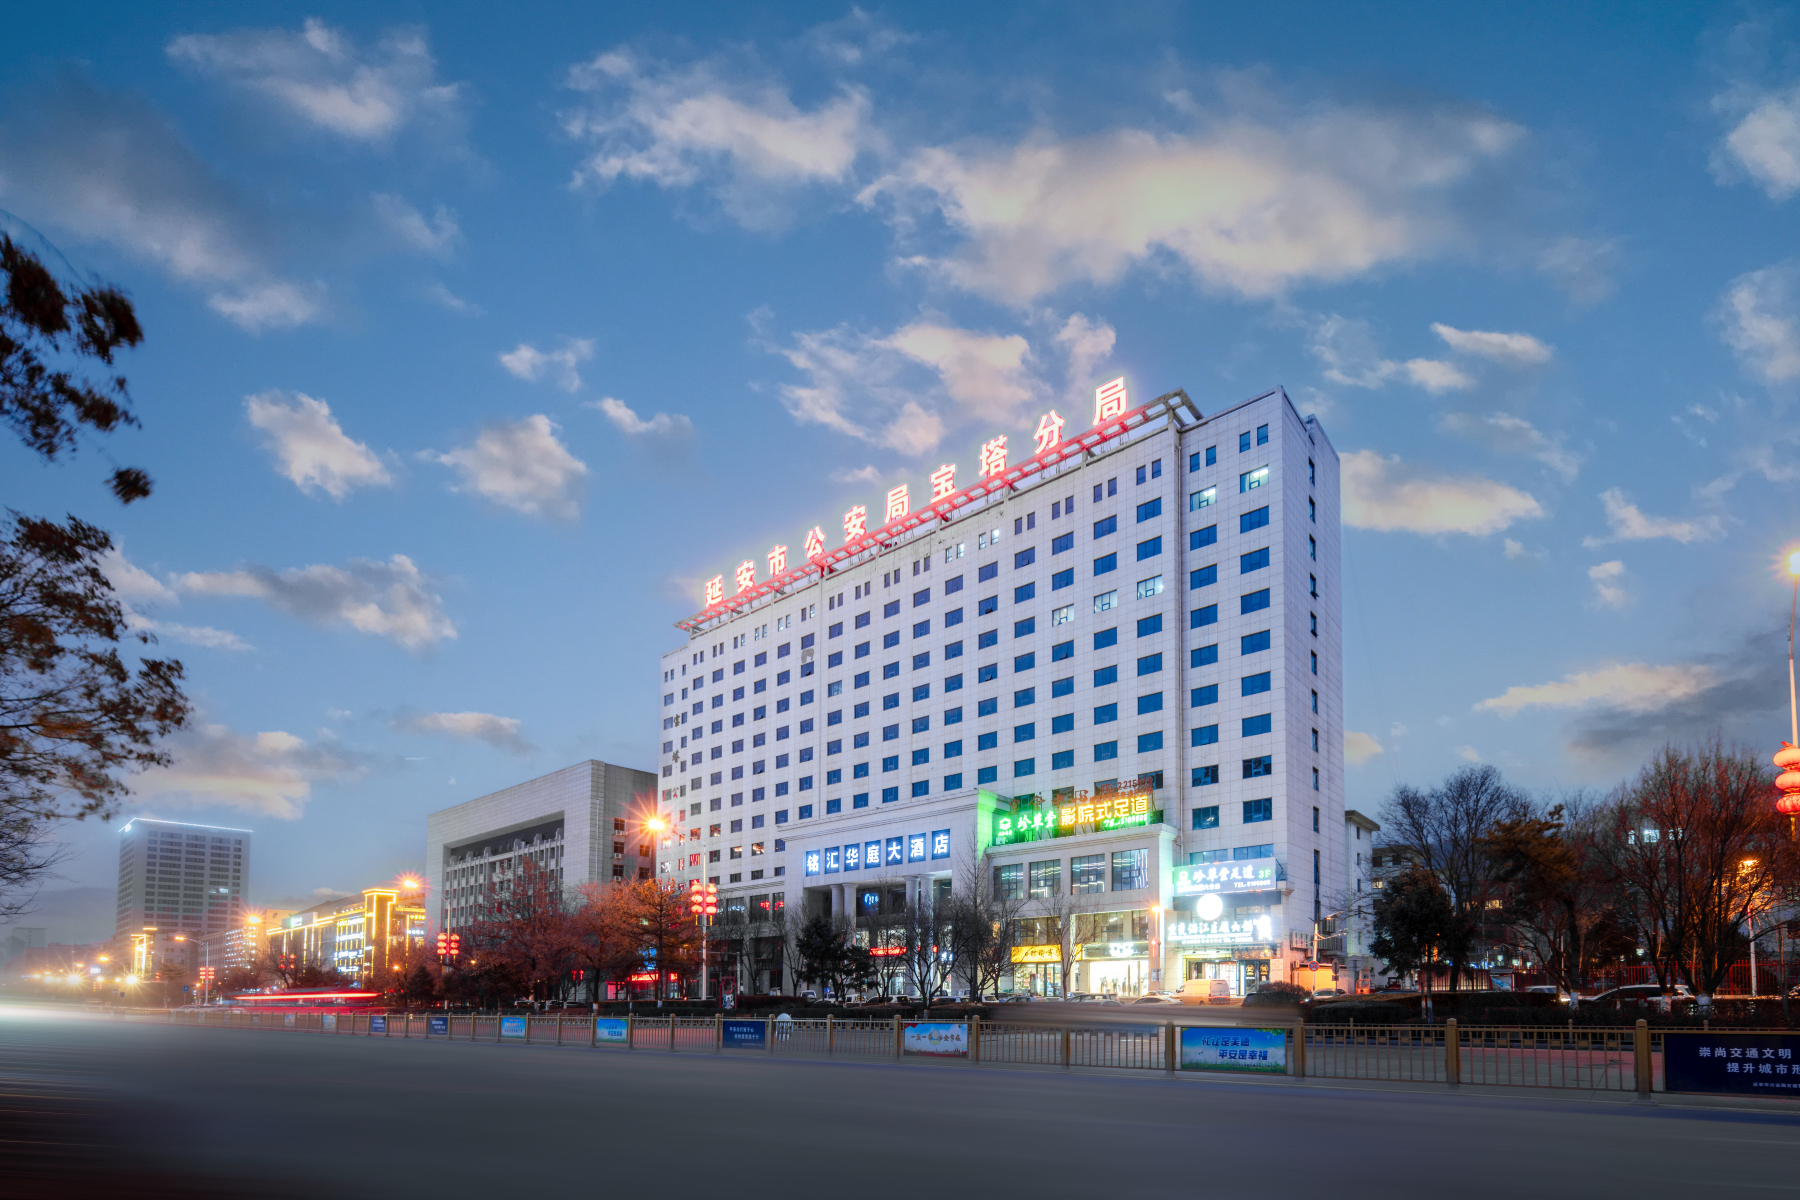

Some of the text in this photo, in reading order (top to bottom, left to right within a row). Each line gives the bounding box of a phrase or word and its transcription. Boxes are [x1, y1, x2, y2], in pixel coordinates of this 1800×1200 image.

[704, 376, 1129, 609] 延安市公安局宝塔分局
[1060, 795, 1149, 827] 影院式足道
[806, 834, 949, 872] 铭汇华庭大酒店
[1258, 870, 1271, 879] 3F
[1202, 1035, 1250, 1047] 礼让是美德
[1218, 1049, 1268, 1061] 平安是幸福
[1699, 1047, 1792, 1059] 崇尚交通文明
